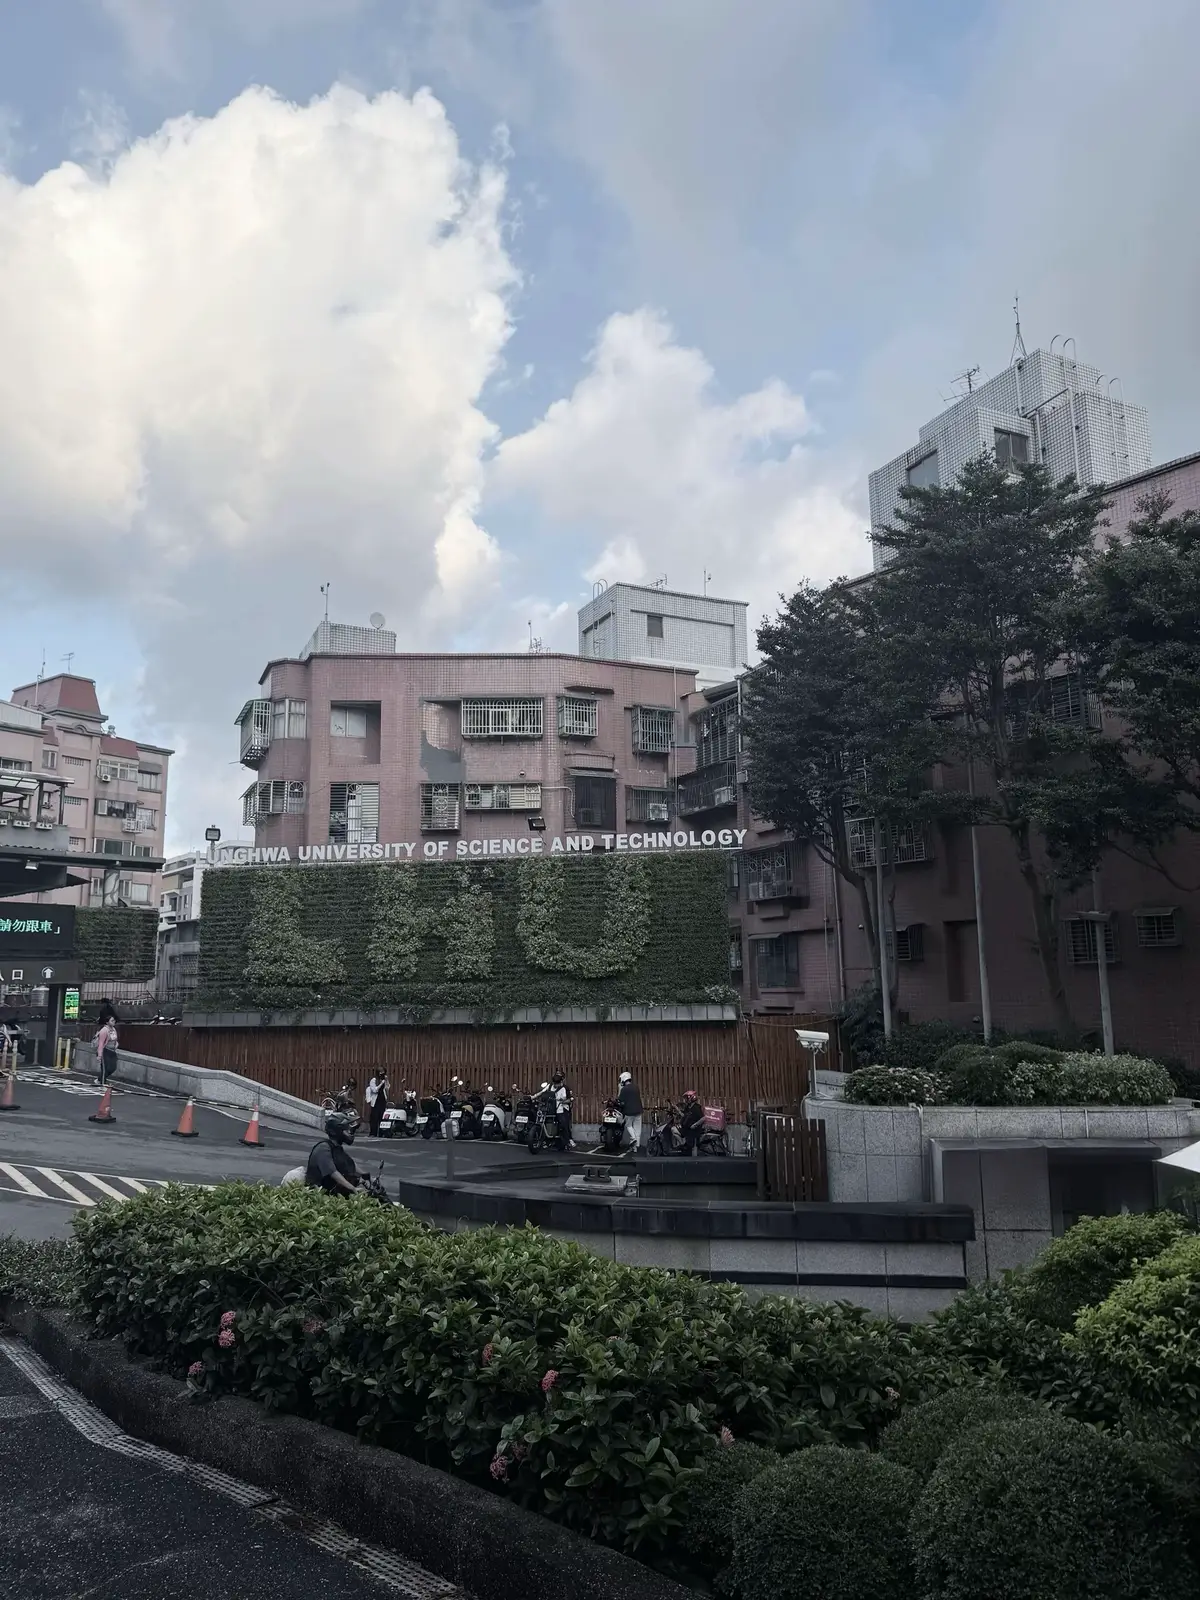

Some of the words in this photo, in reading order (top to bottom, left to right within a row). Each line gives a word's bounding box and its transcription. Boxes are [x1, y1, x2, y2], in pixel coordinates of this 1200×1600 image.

[298, 842, 417, 861] UNIVERSITY
[423, 840, 449, 857] OF
[456, 837, 543, 856] SCIENCE
[550, 835, 594, 852] AND
[601, 828, 748, 850] TECHNOLOGY
